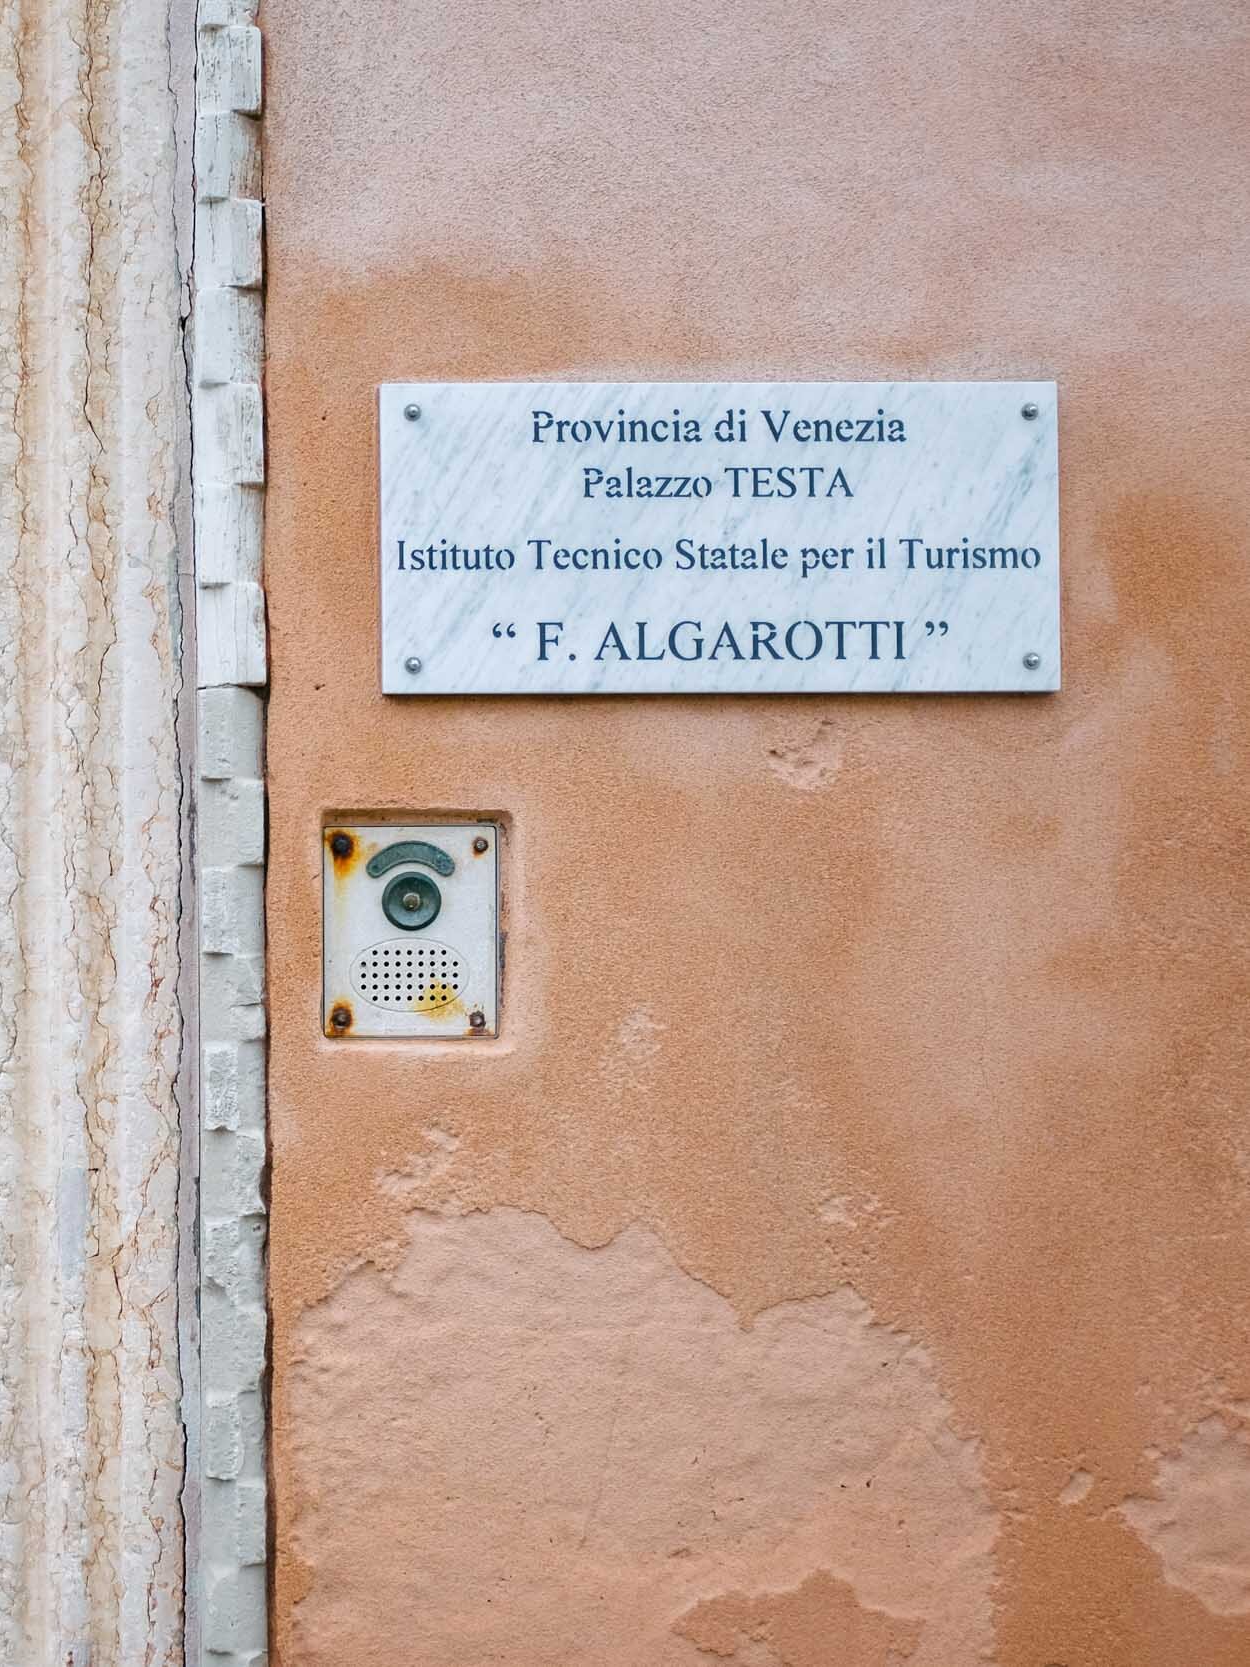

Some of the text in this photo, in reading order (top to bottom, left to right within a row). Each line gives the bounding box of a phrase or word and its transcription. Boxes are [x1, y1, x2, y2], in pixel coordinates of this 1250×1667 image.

[531, 408, 907, 444] Provincia di Venezia
[582, 466, 854, 499] Palazzo TESTA
[397, 537, 1041, 579] Istituto Tecnico Statale per il Turismo
